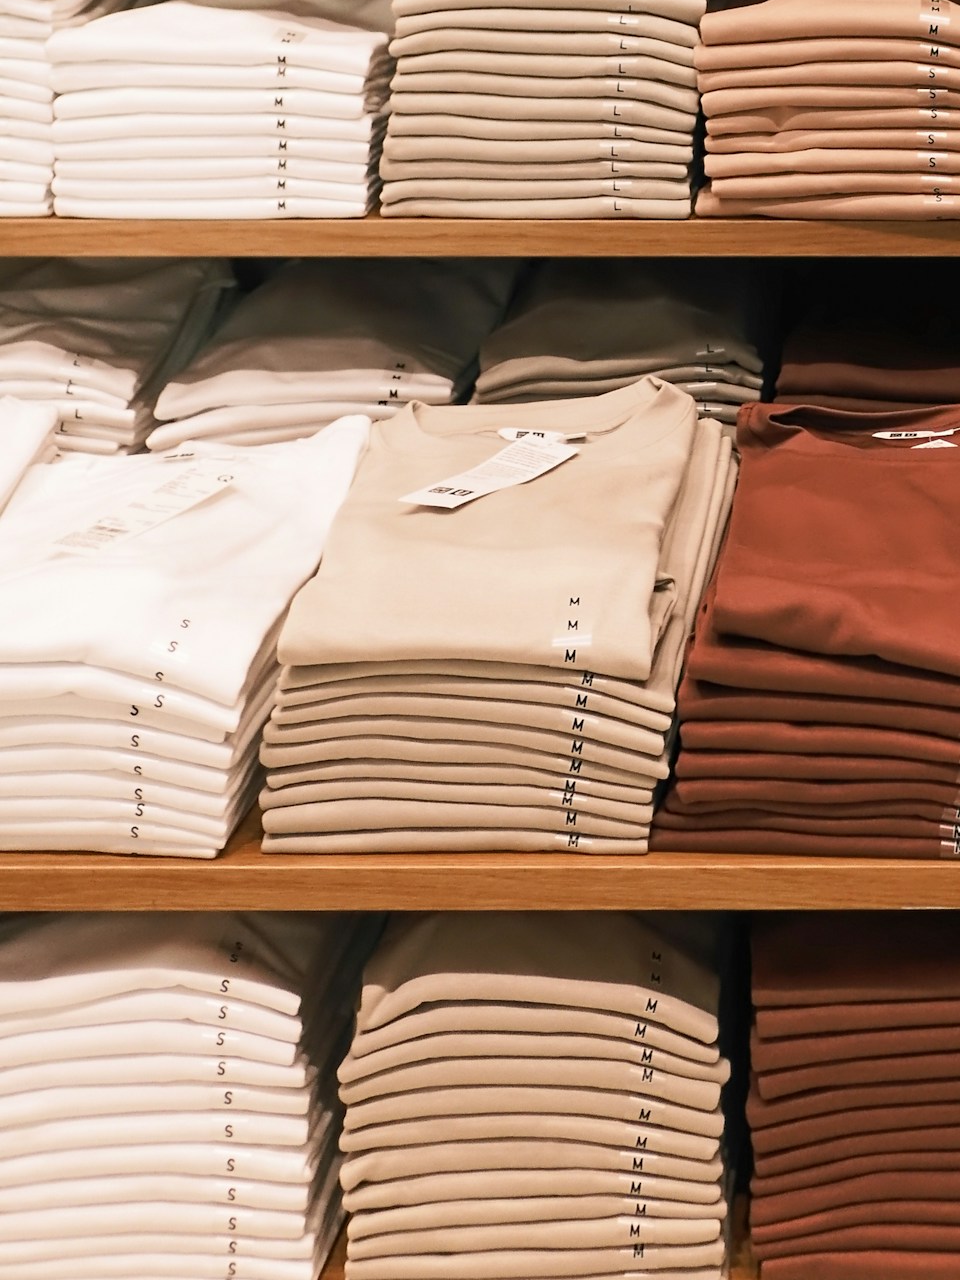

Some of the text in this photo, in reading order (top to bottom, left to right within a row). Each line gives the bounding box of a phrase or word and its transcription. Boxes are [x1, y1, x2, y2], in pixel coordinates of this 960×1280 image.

[929, 25, 938, 35] M
[930, 47, 939, 57] M
[619, 64, 626, 73] L
[617, 82, 624, 92] L
[275, 98, 282, 106] M
[614, 106, 620, 116] L
[931, 109, 937, 119] S
[277, 120, 285, 128] M
[279, 141, 287, 150] M
[928, 135, 935, 144] S
[611, 146, 618, 156] L
[278, 160, 286, 169] M
[929, 157, 936, 168] S
[278, 201, 285, 209] M
[614, 201, 621, 211] L
[390, 390, 398, 398] M
[75, 409, 82, 419] L
[569, 597, 580, 606] M
[568, 620, 578, 630] M
[168, 641, 178, 652] S
[564, 649, 576, 663] M
[154, 695, 165, 708] S
[576, 694, 588, 707] M
[572, 717, 584, 732] M
[131, 735, 139, 747] S
[572, 740, 583, 754] M
[134, 788, 142, 800] S
[566, 811, 577, 825] M
[131, 826, 139, 838] S
[220, 980, 230, 993] S
[645, 998, 658, 1013] M
[219, 1006, 227, 1019] S
[634, 1023, 647, 1038] M
[217, 1032, 226, 1045] S
[641, 1049, 653, 1063] M
[224, 1091, 233, 1104] S
[225, 1125, 233, 1137] S
[636, 1136, 648, 1148] M
[227, 1158, 235, 1171] S
[633, 1158, 643, 1171] M
[631, 1181, 641, 1194] M
[229, 1217, 237, 1230] S
[630, 1224, 640, 1237] M
